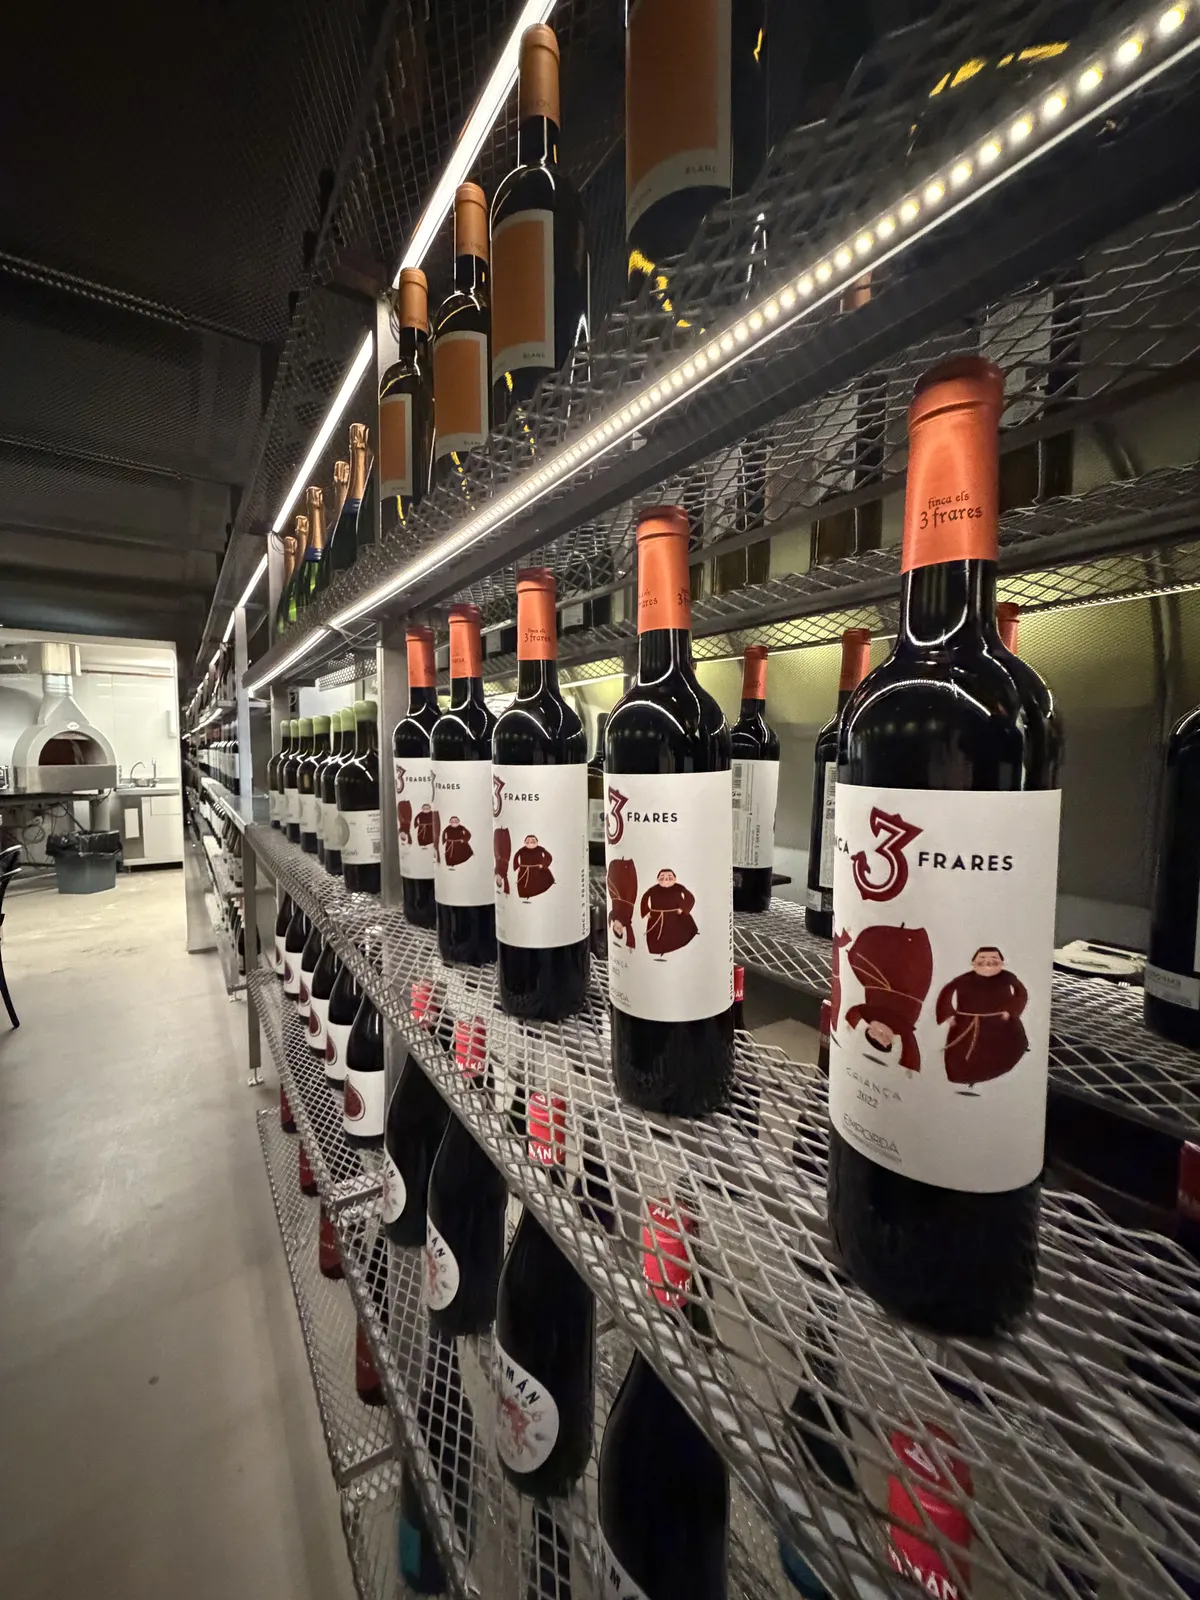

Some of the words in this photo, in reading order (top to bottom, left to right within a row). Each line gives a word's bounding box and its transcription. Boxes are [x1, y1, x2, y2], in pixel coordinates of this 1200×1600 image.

[928, 495, 953, 511] finca
[955, 490, 970, 502] els
[919, 511, 930, 530] 3
[932, 506, 984, 528] frares
[435, 782, 461, 790] FRARES
[504, 792, 540, 802] FRARES
[605, 785, 629, 846] 3
[626, 811, 679, 823] FRARES
[835, 836, 850, 855] CA
[850, 805, 925, 903] 3
[917, 851, 1014, 872] FRARES
